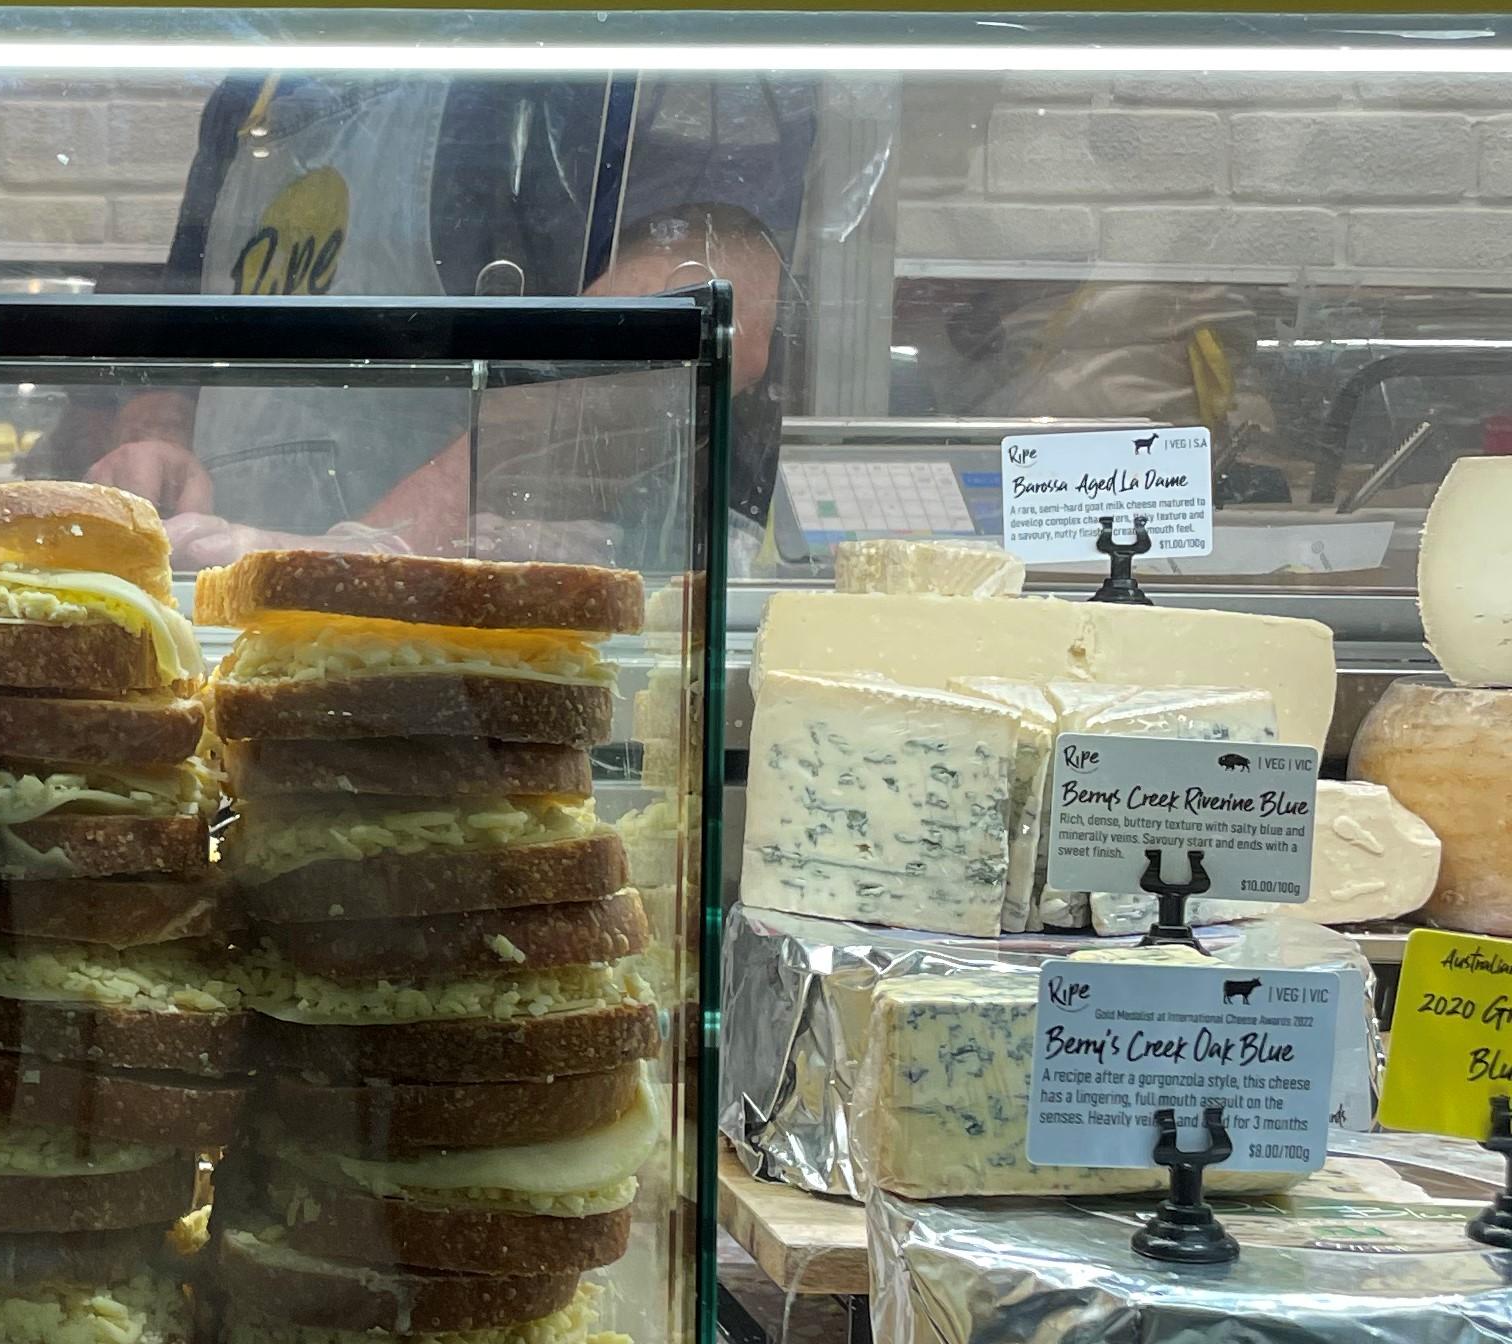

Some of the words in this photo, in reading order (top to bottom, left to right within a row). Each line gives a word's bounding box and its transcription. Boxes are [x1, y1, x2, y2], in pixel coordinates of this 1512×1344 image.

[1008, 444, 1037, 465] Ripe
[1169, 439, 1187, 450] VEG
[1012, 476, 1068, 499] Barossa
[1075, 468, 1117, 500] Aged
[1119, 468, 1139, 493] La
[1144, 469, 1189, 490] Dame
[1010, 505, 1016, 515] A
[1039, 503, 1083, 514] semi-hard
[1085, 502, 1103, 514] goat
[1106, 500, 1124, 510] milk
[1126, 500, 1157, 509] cheese
[1159, 498, 1195, 508] matured
[1197, 498, 1206, 506] to
[1010, 518, 1043, 528] develop
[1045, 516, 1081, 527] complex
[1156, 512, 1187, 521] texture
[1189, 510, 1205, 519] and
[1011, 533, 1016, 541] a
[1054, 529, 1078, 539] nutty
[1147, 525, 1175, 534] mouth
[1063, 745, 1100, 769] Ripe
[1265, 758, 1285, 770] VEG
[1295, 759, 1312, 771] VIC
[1062, 780, 1121, 812] Berrys
[1127, 785, 1180, 812] Creek
[1184, 787, 1255, 815] Riverine
[1260, 791, 1309, 817] Blue
[1059, 812, 1085, 826] Rich,
[1088, 814, 1121, 828] dense,
[1124, 816, 1162, 830] buttery
[1165, 819, 1203, 831] texture
[1205, 821, 1229, 832] with
[1231, 822, 1257, 836] salty
[1260, 823, 1283, 836] blue
[1286, 825, 1305, 836] and
[1057, 846, 1089, 857] sweet
[1058, 830, 1108, 844] minerally
[1142, 832, 1184, 848] Savoury
[1187, 837, 1212, 848] start
[1215, 838, 1234, 849] and
[1237, 839, 1263, 850] ends
[1266, 840, 1289, 852] with
[1291, 843, 1298, 852] a
[1241, 879, 1300, 896] $10.00/100g
[1048, 976, 1090, 1006] Ripe
[1276, 987, 1299, 1003] VEG
[1309, 988, 1329, 1003] VIC
[1417, 993, 1476, 1019] 2020
[1045, 1025, 1120, 1064] Berry's
[1127, 1030, 1188, 1064] Creek
[1193, 1027, 1235, 1066] Oak
[1240, 1032, 1295, 1067] Blue
[1467, 1047, 1512, 1081] Blu
[1042, 1068, 1050, 1082] A
[1054, 1069, 1092, 1085] recipe
[1094, 1069, 1125, 1084] after
[1128, 1074, 1135, 1084] a
[1138, 1073, 1204, 1088] gorgonzola
[1208, 1073, 1239, 1090] style,
[1243, 1074, 1266, 1089] this
[1268, 1076, 1311, 1090] cheese
[1040, 1089, 1063, 1103] has
[1065, 1091, 1072, 1103] a
[1135, 1091, 1155, 1106] full
[1158, 1094, 1196, 1107] mouth
[1200, 1095, 1244, 1109] assault
[1246, 1097, 1261, 1109] on
[1264, 1096, 1284, 1110] the
[1039, 1111, 1084, 1124] senses.
[1088, 1110, 1132, 1128] Heavily
[1176, 1114, 1199, 1128] and
[1233, 1115, 1250, 1129] for
[1253, 1115, 1260, 1129] 3
[1263, 1117, 1308, 1131] months
